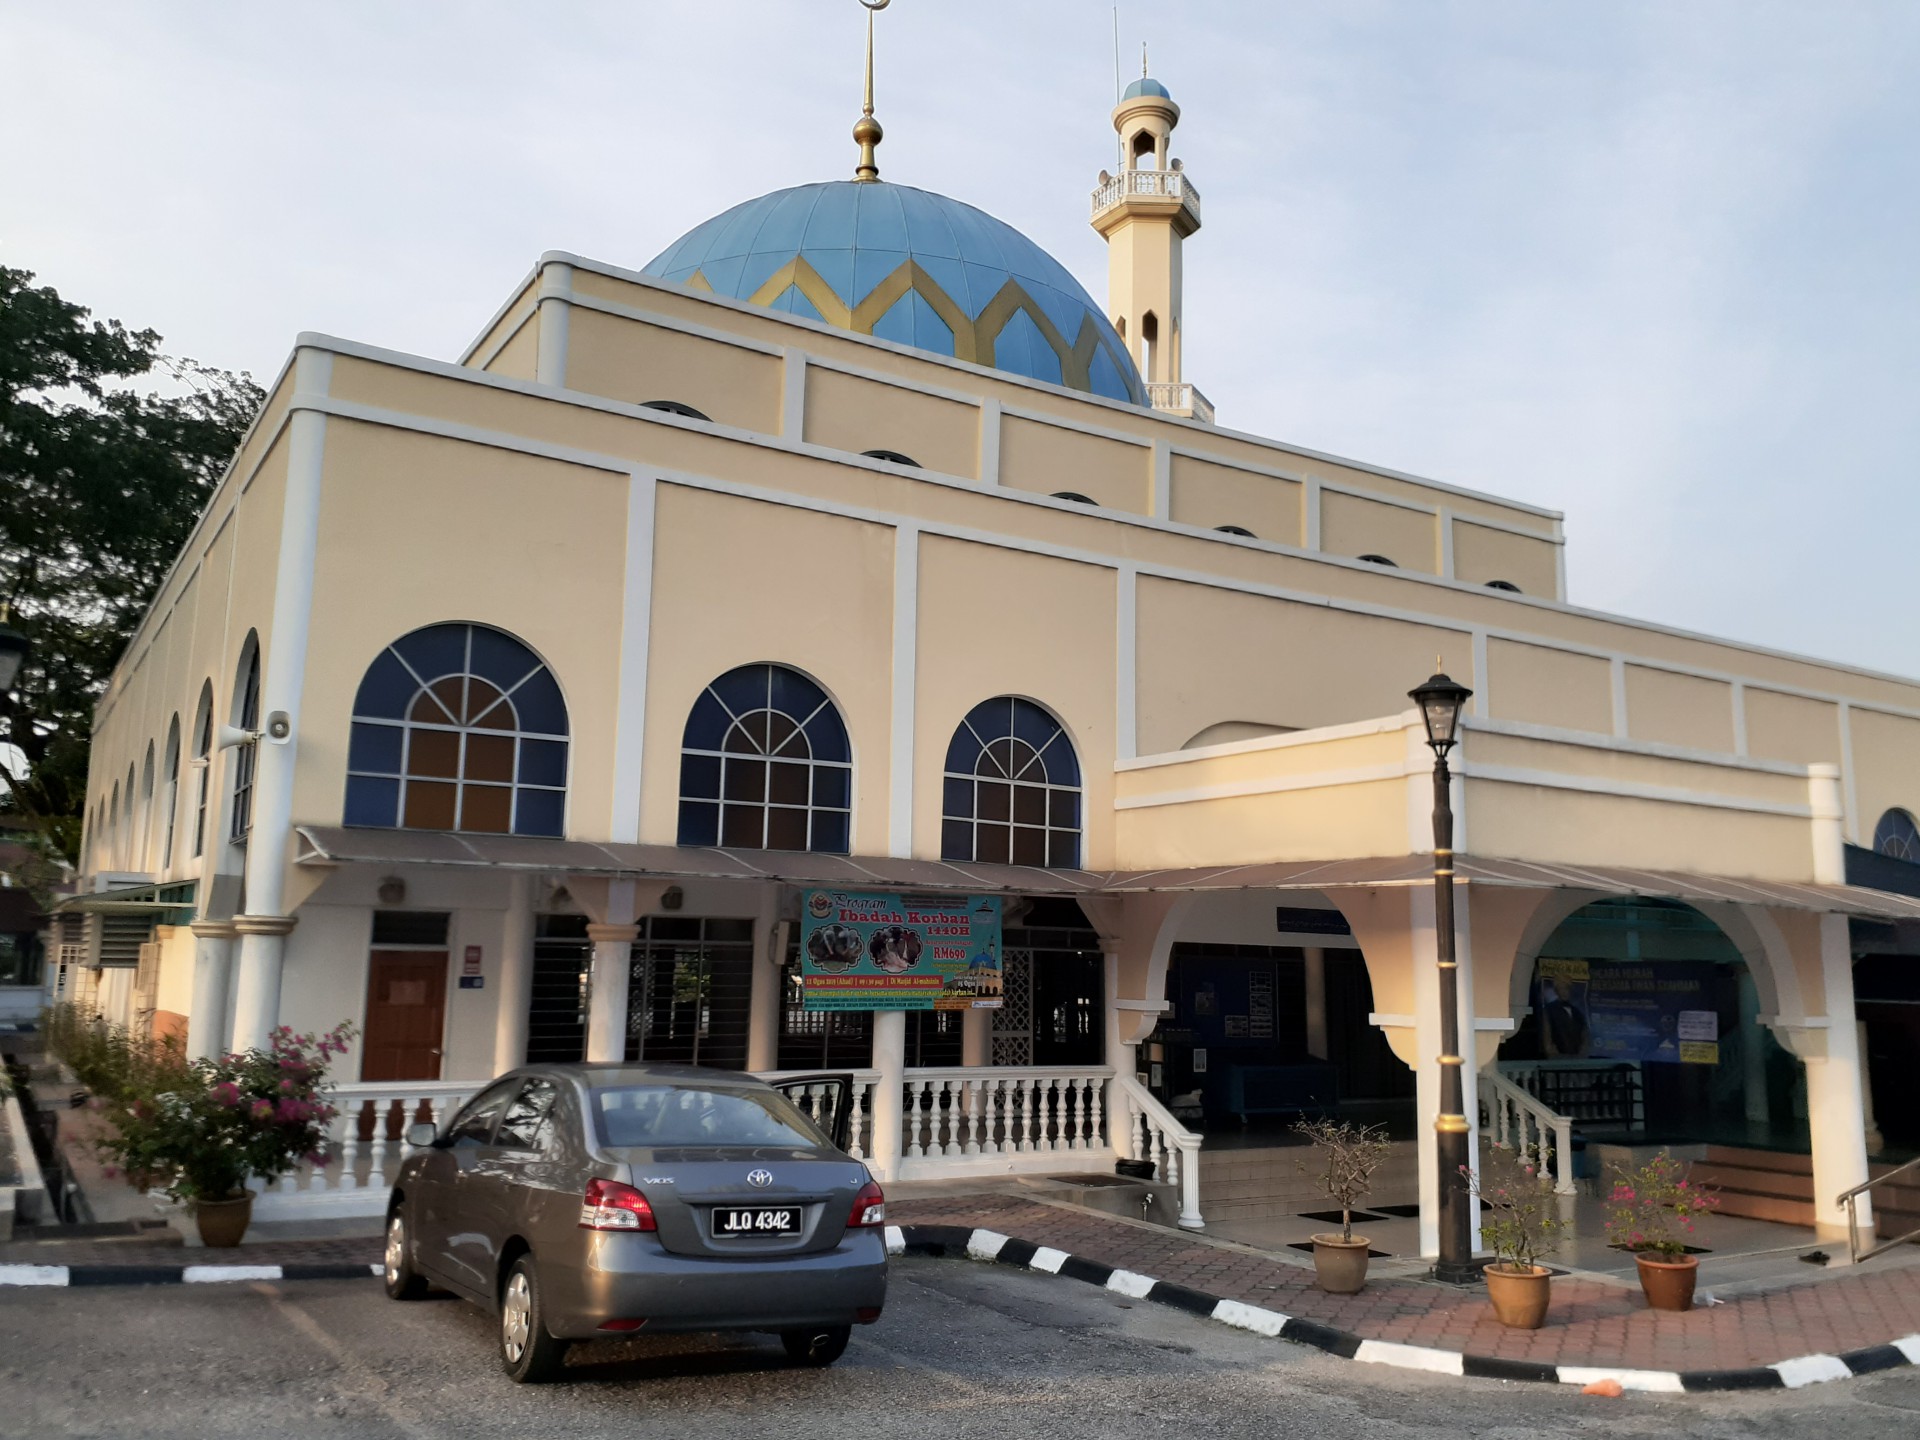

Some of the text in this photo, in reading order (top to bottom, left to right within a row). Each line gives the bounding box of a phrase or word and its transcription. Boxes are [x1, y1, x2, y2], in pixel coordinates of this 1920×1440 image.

[832, 892, 887, 911] Program
[838, 908, 903, 923] Ibadah
[906, 911, 970, 924] Korban
[927, 926, 970, 936] 1440H
[933, 946, 966, 960] RM690
[896, 977, 912, 986] Masjid
[643, 1176, 675, 1185] VIOS
[724, 1211, 790, 1230] JLQ 4342
